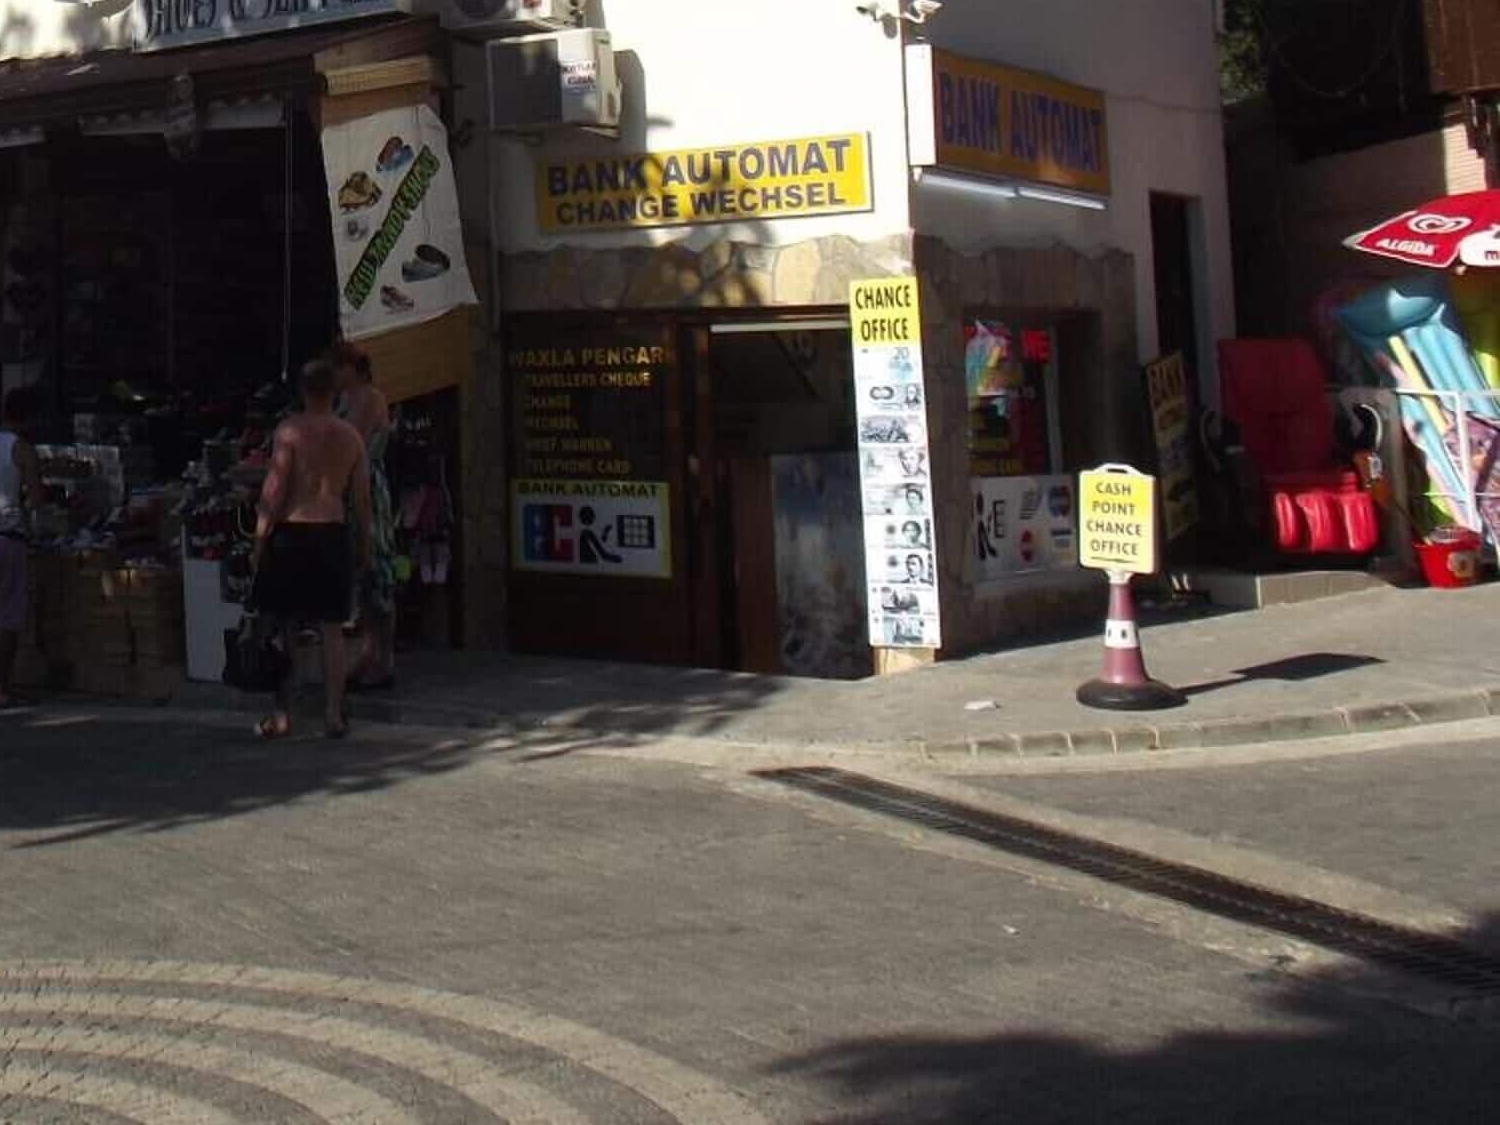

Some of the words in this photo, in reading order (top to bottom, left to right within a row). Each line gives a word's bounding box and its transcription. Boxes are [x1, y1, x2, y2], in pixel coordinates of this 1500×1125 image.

[938, 71, 1000, 154] BANK
[1010, 88, 1106, 173] AUTOMAT
[548, 158, 646, 196] BANK
[662, 139, 850, 188] AUTOMAT
[556, 193, 679, 225] CHANGE
[690, 181, 845, 215] WECHSEL
[1375, 238, 1436, 256] ALGIDA
[855, 285, 912, 310] CHANCE
[860, 318, 910, 342] OFFICE
[600, 371, 652, 388] CHEQUE
[516, 481, 567, 494] BANK
[573, 482, 659, 498] AUTOMAT
[1095, 482, 1132, 496] CASH
[1092, 500, 1136, 516] POINT
[1086, 520, 1142, 536] CHANCE
[1090, 538, 1140, 556] OFFICE
